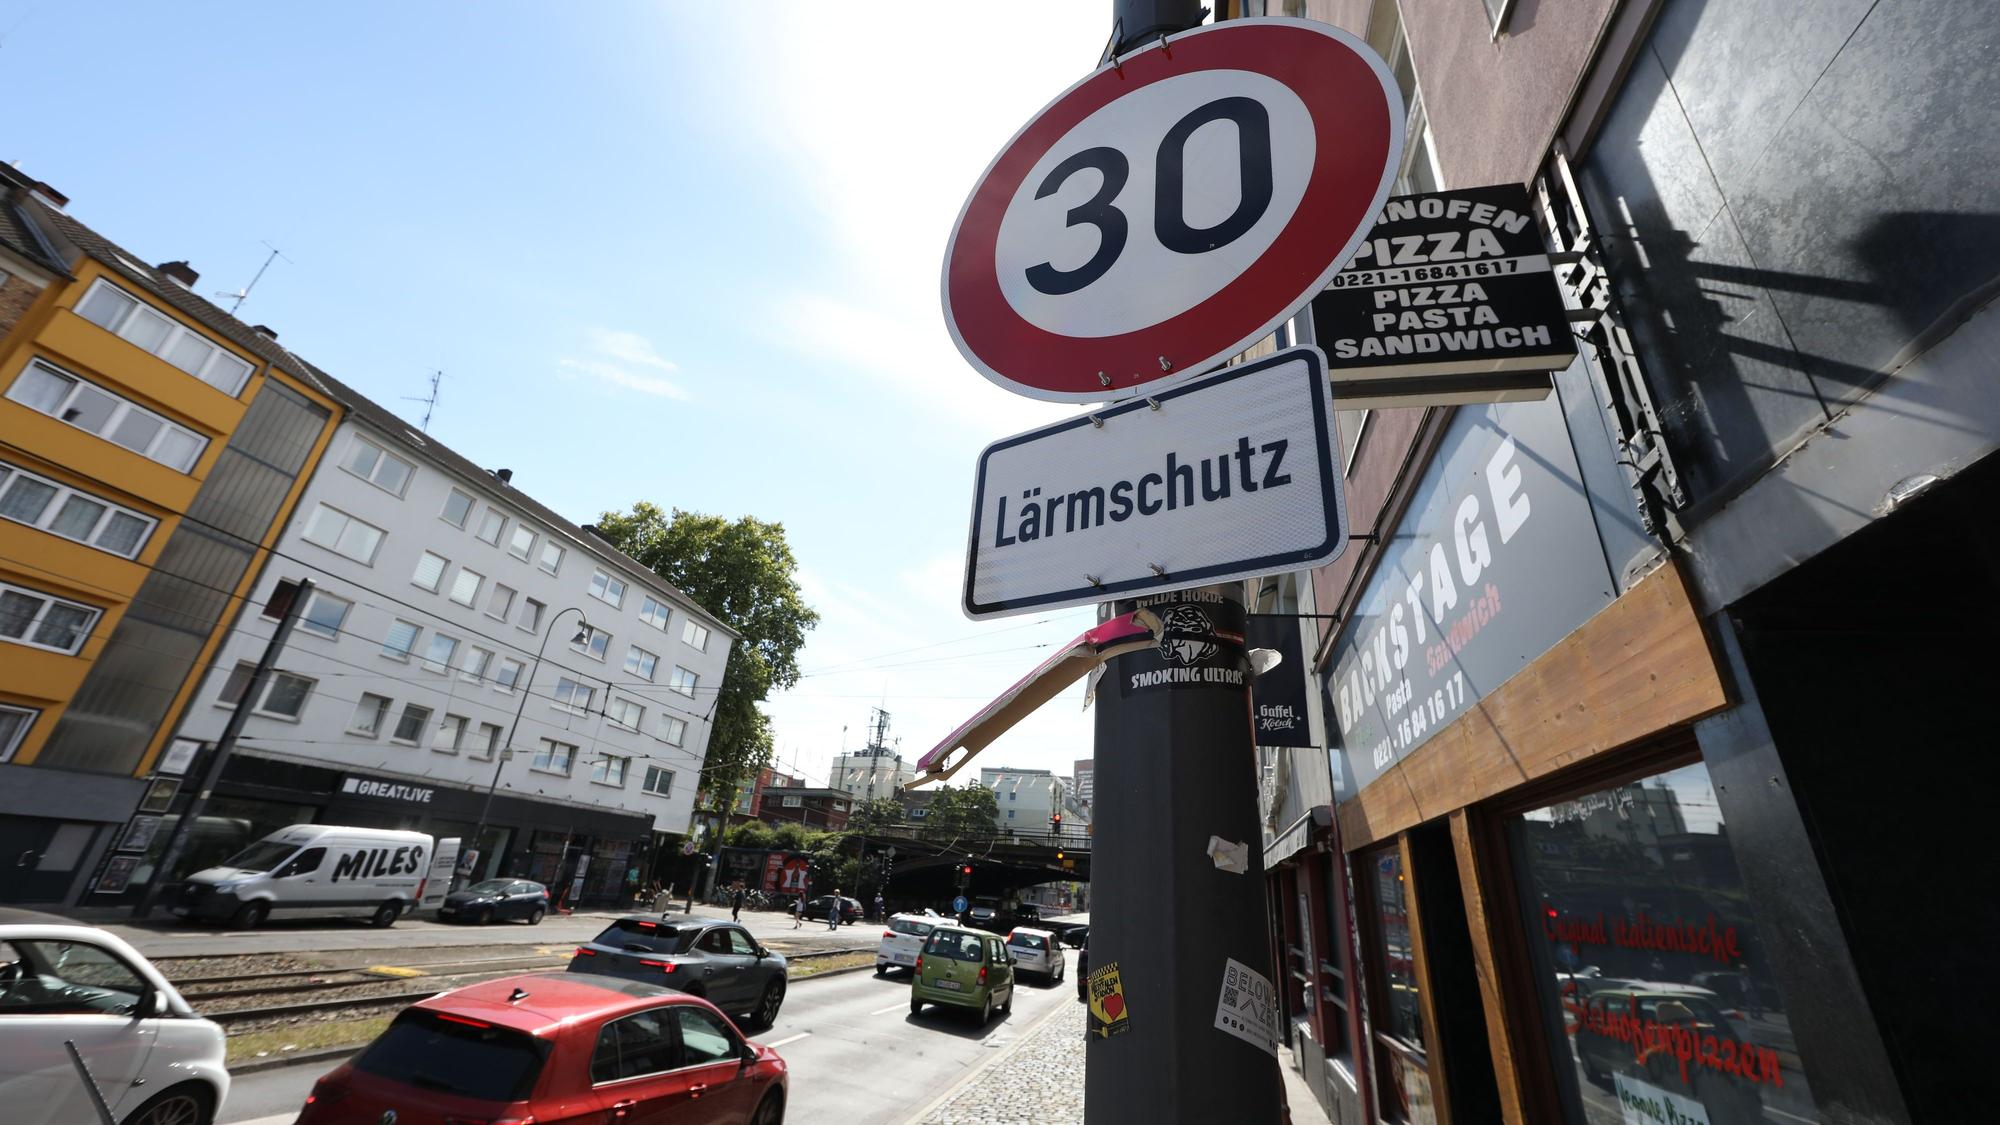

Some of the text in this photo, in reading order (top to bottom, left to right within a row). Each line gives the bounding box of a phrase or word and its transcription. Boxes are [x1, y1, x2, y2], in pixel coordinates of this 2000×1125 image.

[1024, 95, 1274, 297] 30
[1343, 227, 1506, 270] PIZZA
[1332, 259, 1519, 288] 0221-16841617
[1373, 282, 1489, 309] PIZZA
[1372, 305, 1500, 333] PASTA
[1334, 324, 1552, 359] SANDWICH
[994, 436, 1292, 549] Lärmschutz
[1338, 433, 1531, 736] BACKSTAGE
[1425, 581, 1502, 678] Sandwich
[1131, 667, 1243, 689] SMOKING ULTRAS
[1260, 704, 1294, 718] Gaffel
[1385, 677, 1413, 721] Pasta
[1260, 718, 1295, 731] Kölsch
[1373, 735, 1393, 770] 0221
[1397, 717, 1412, 749] 16
[1411, 704, 1427, 738] 84
[1427, 689, 1446, 725] 16
[1445, 670, 1464, 711] 17
[330, 845, 424, 884] MILES
[1542, 901, 1740, 963] Original italienische
